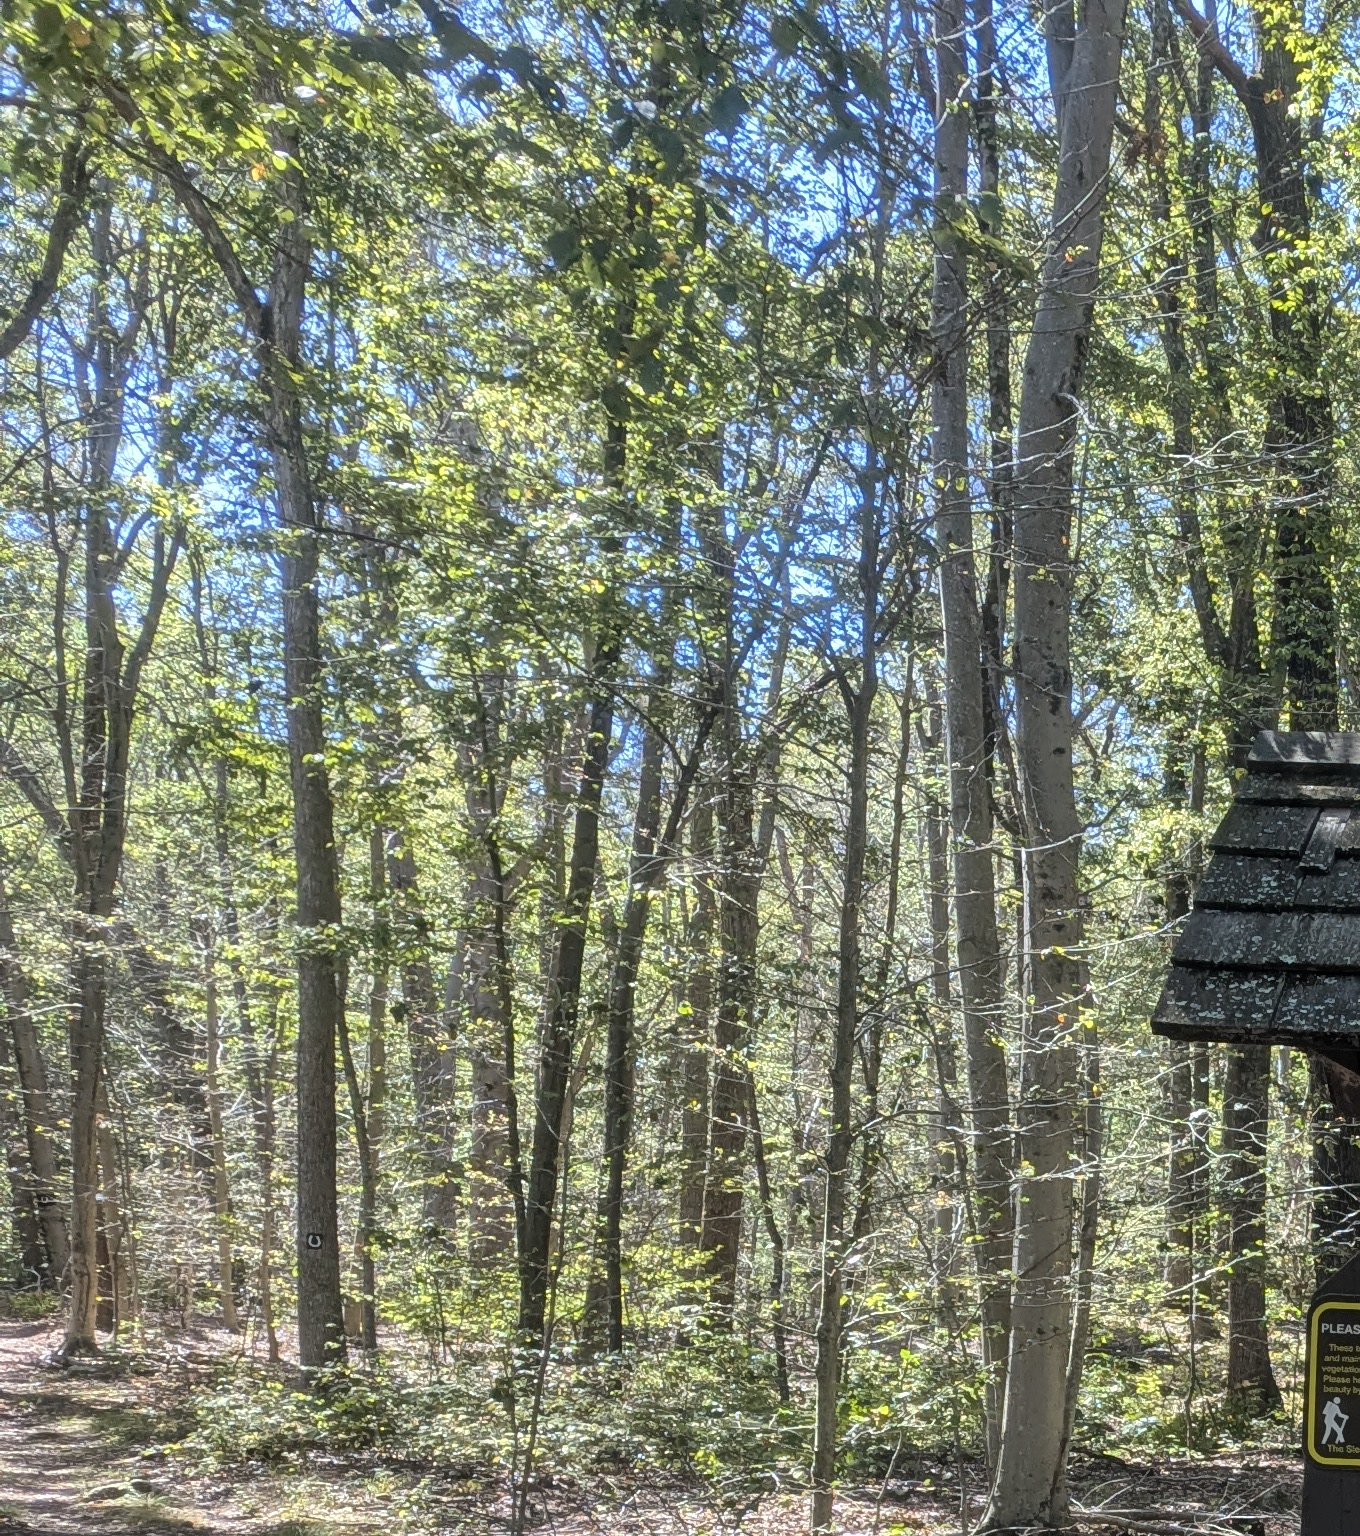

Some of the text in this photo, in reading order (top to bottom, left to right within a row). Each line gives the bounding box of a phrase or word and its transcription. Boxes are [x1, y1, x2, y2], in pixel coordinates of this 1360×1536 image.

[1328, 1343, 1353, 1352] These
[1324, 1354, 1340, 1362] and
[1323, 1374, 1351, 1384] Please
[1323, 1385, 1351, 1395] beauty
[1327, 1444, 1344, 1453] The
